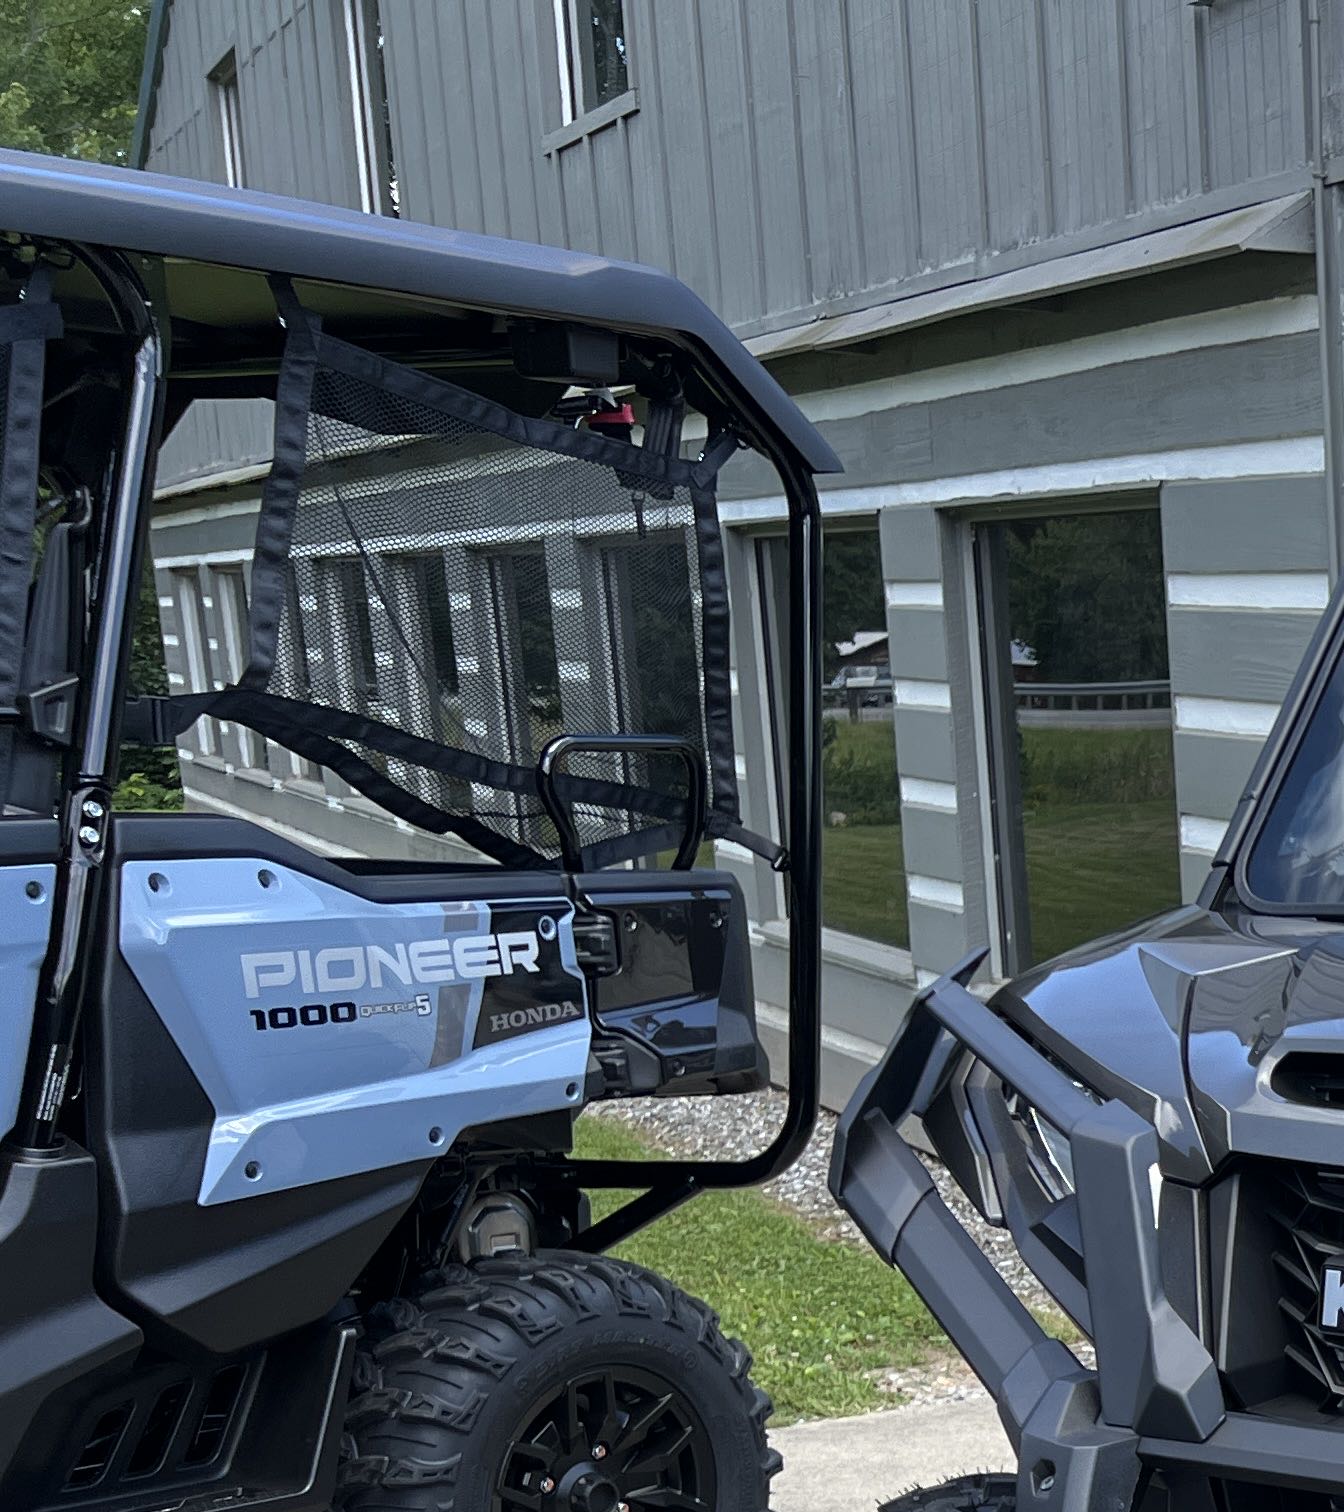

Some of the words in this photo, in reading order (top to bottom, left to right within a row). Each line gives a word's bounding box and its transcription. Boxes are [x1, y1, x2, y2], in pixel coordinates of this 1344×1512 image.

[240, 931, 540, 999] PIONEER
[250, 1001, 357, 1031] 1000
[490, 1000, 580, 1033] HONDA
